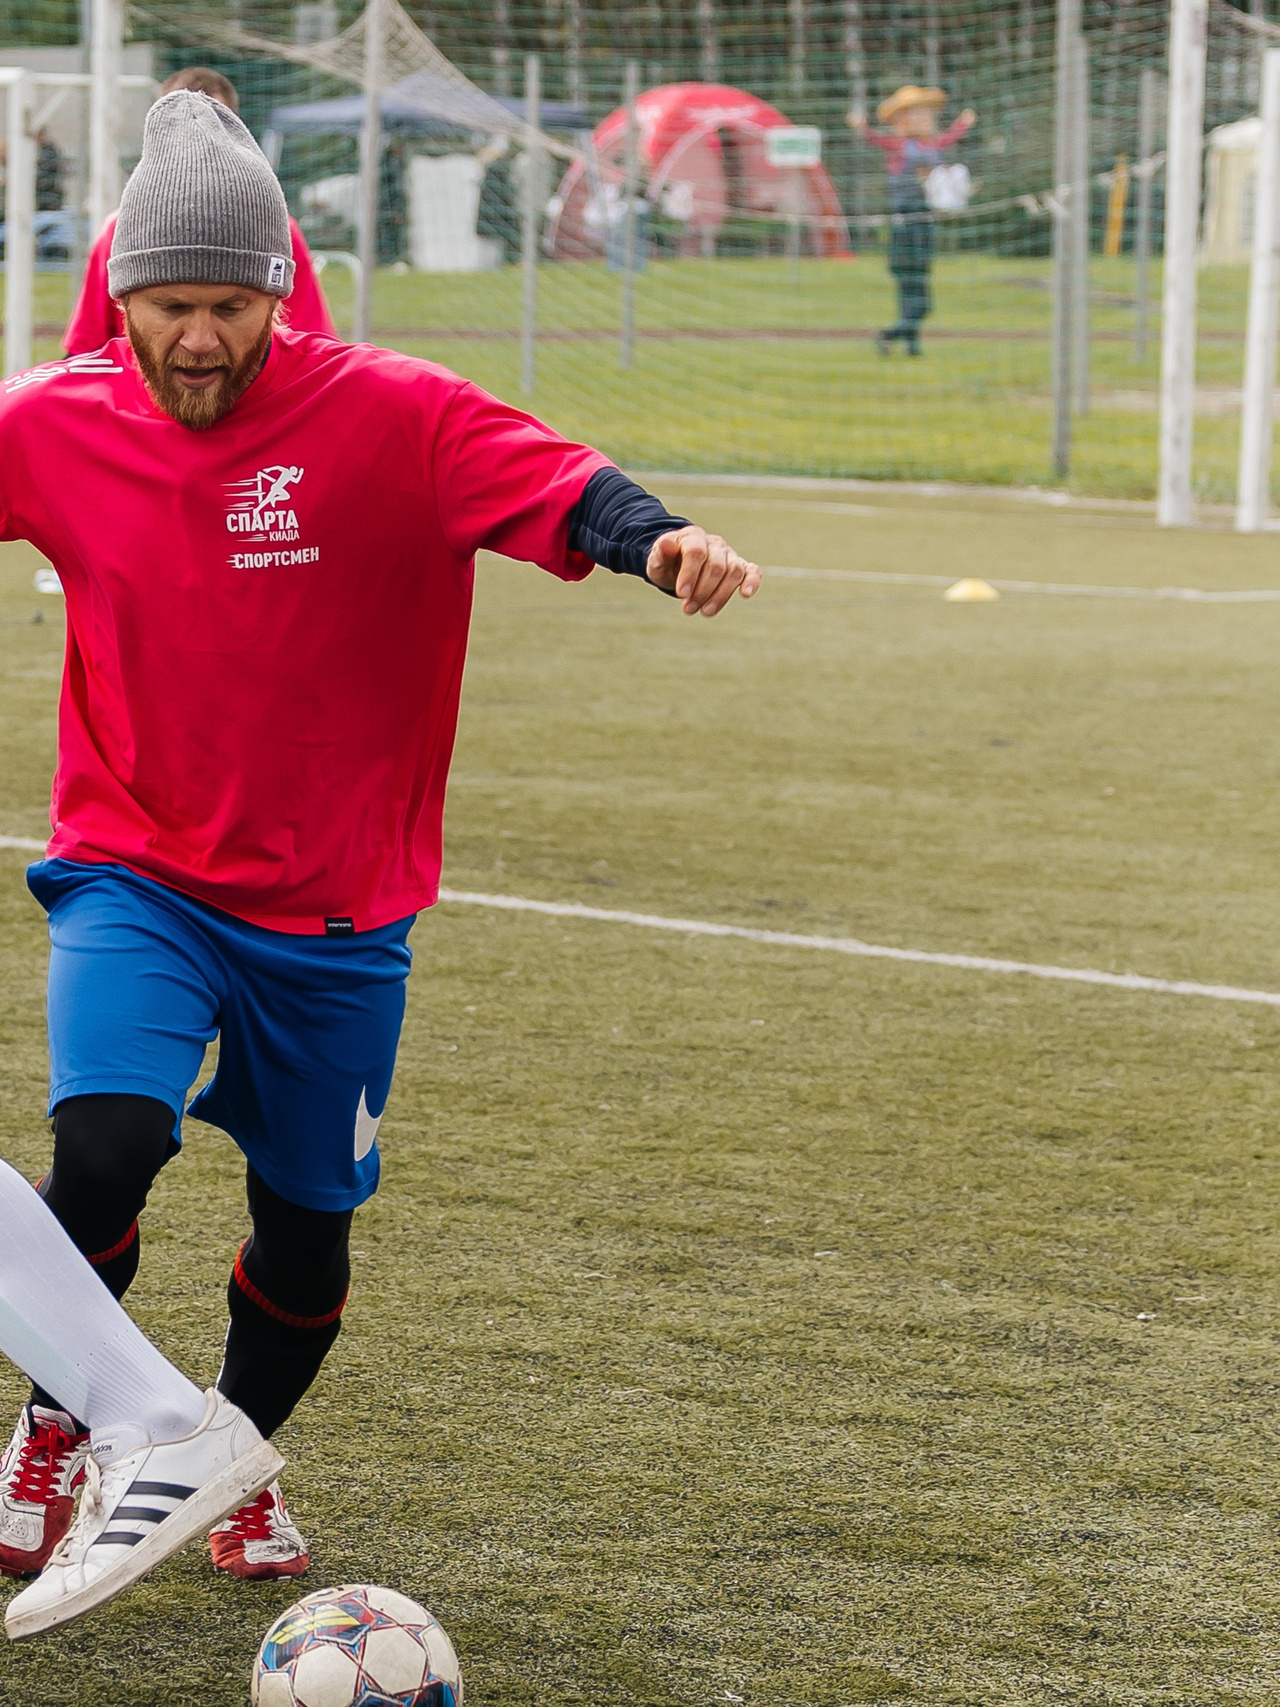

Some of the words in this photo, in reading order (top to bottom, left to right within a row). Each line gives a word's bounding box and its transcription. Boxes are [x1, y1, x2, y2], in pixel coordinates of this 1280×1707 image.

[226, 509, 299, 533] СПАРТА
[269, 529, 300, 542] КИАДА
[232, 546, 320, 569] СПОРТСМЕН
